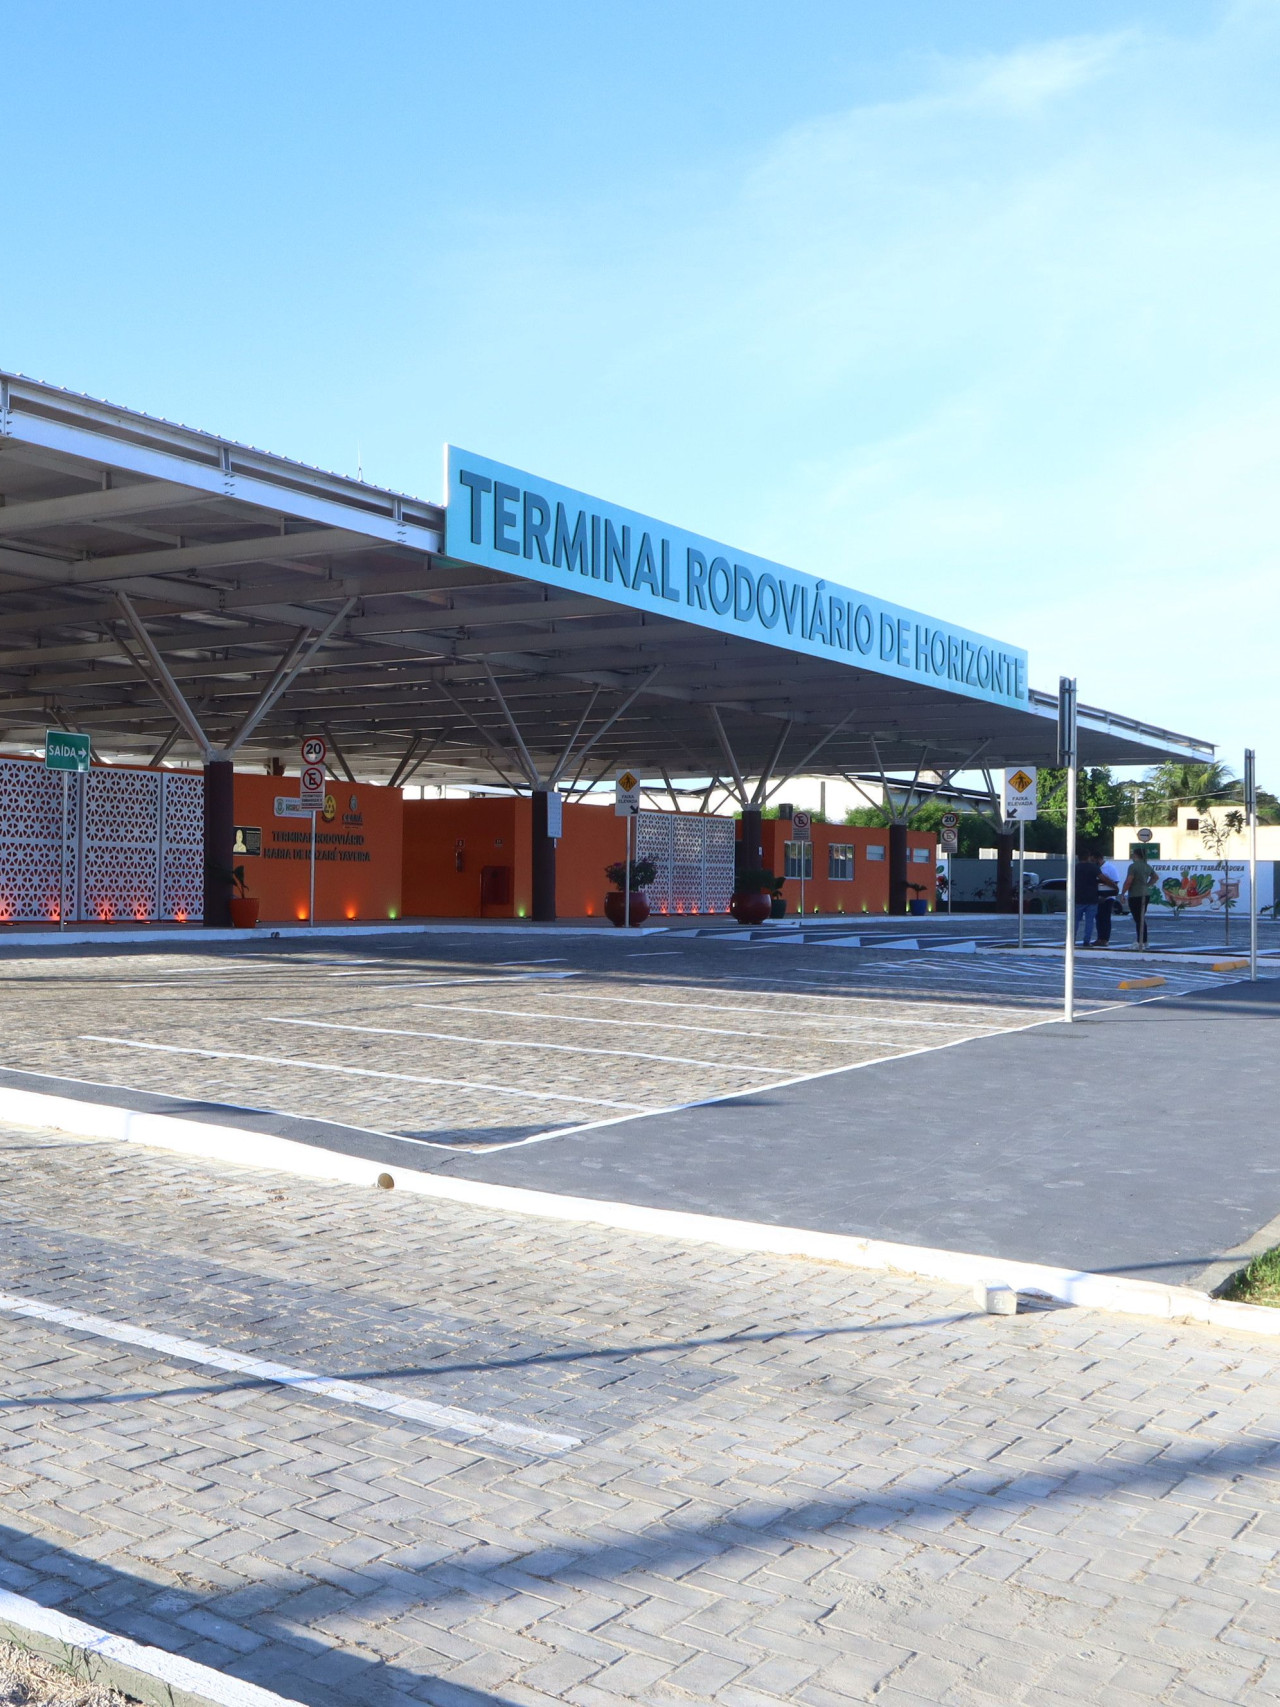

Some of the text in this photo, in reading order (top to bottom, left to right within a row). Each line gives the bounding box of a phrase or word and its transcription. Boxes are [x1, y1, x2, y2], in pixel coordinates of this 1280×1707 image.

[460, 469, 1025, 699] TERMINAL RODOVIÁRIO DE HORIZONTE
[48, 743, 76, 757] SAÍDA
[305, 743, 322, 755] 20
[944, 815, 955, 823] 20
[315, 831, 364, 846] RODOVIÁRIO
[263, 848, 292, 860] MARIA
[293, 849, 304, 860] DE
[338, 849, 371, 862] TAVEIRA
[1151, 864, 1170, 872] TERRA
[1171, 864, 1180, 872] DE
[1180, 864, 1198, 872] GENTE
